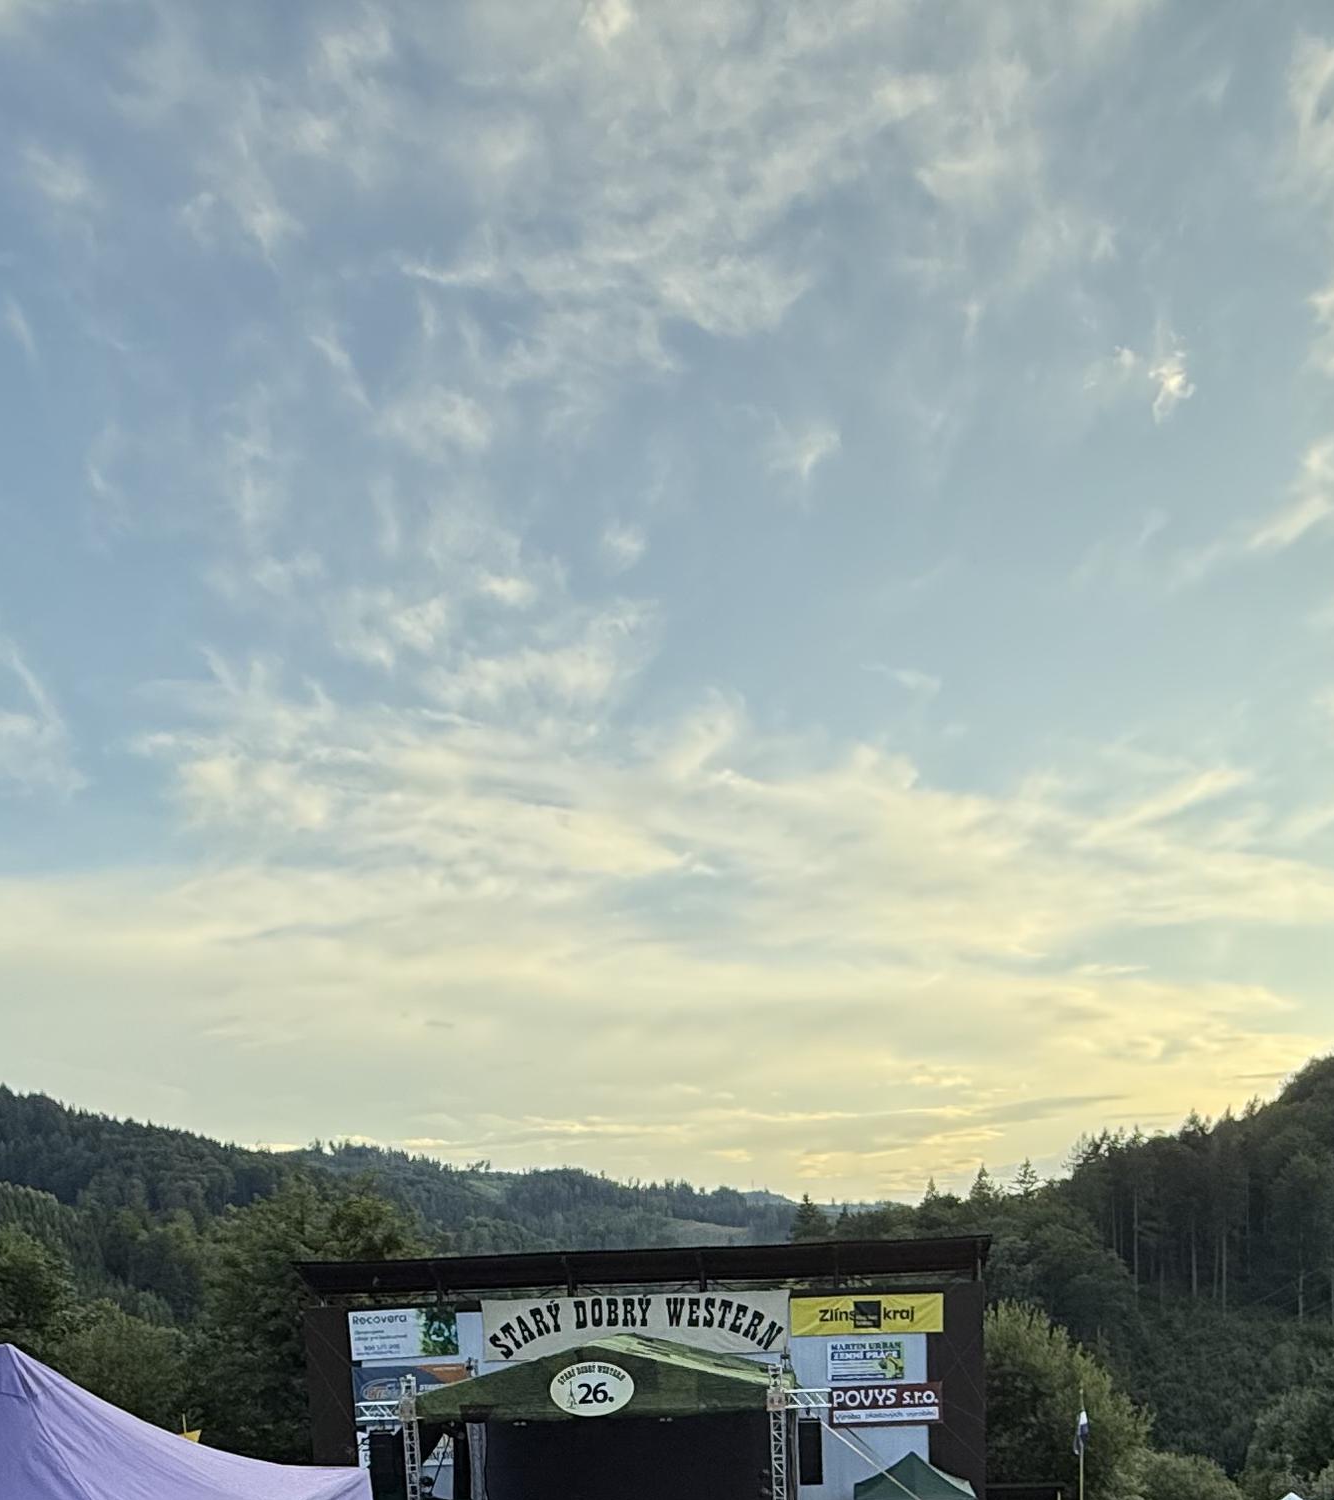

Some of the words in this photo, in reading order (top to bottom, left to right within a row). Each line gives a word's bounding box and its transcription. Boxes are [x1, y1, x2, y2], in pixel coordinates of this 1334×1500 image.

[352, 1314, 407, 1325] Recovera
[883, 1306, 915, 1322] kraj
[489, 1300, 561, 1359] STARÝ
[573, 1295, 651, 1329] DOBRÝ
[666, 1297, 784, 1350] WESTERN
[577, 1382, 615, 1405] 26.
[832, 1388, 897, 1408] POVYS
[901, 1390, 940, 1405] s.r.o.
